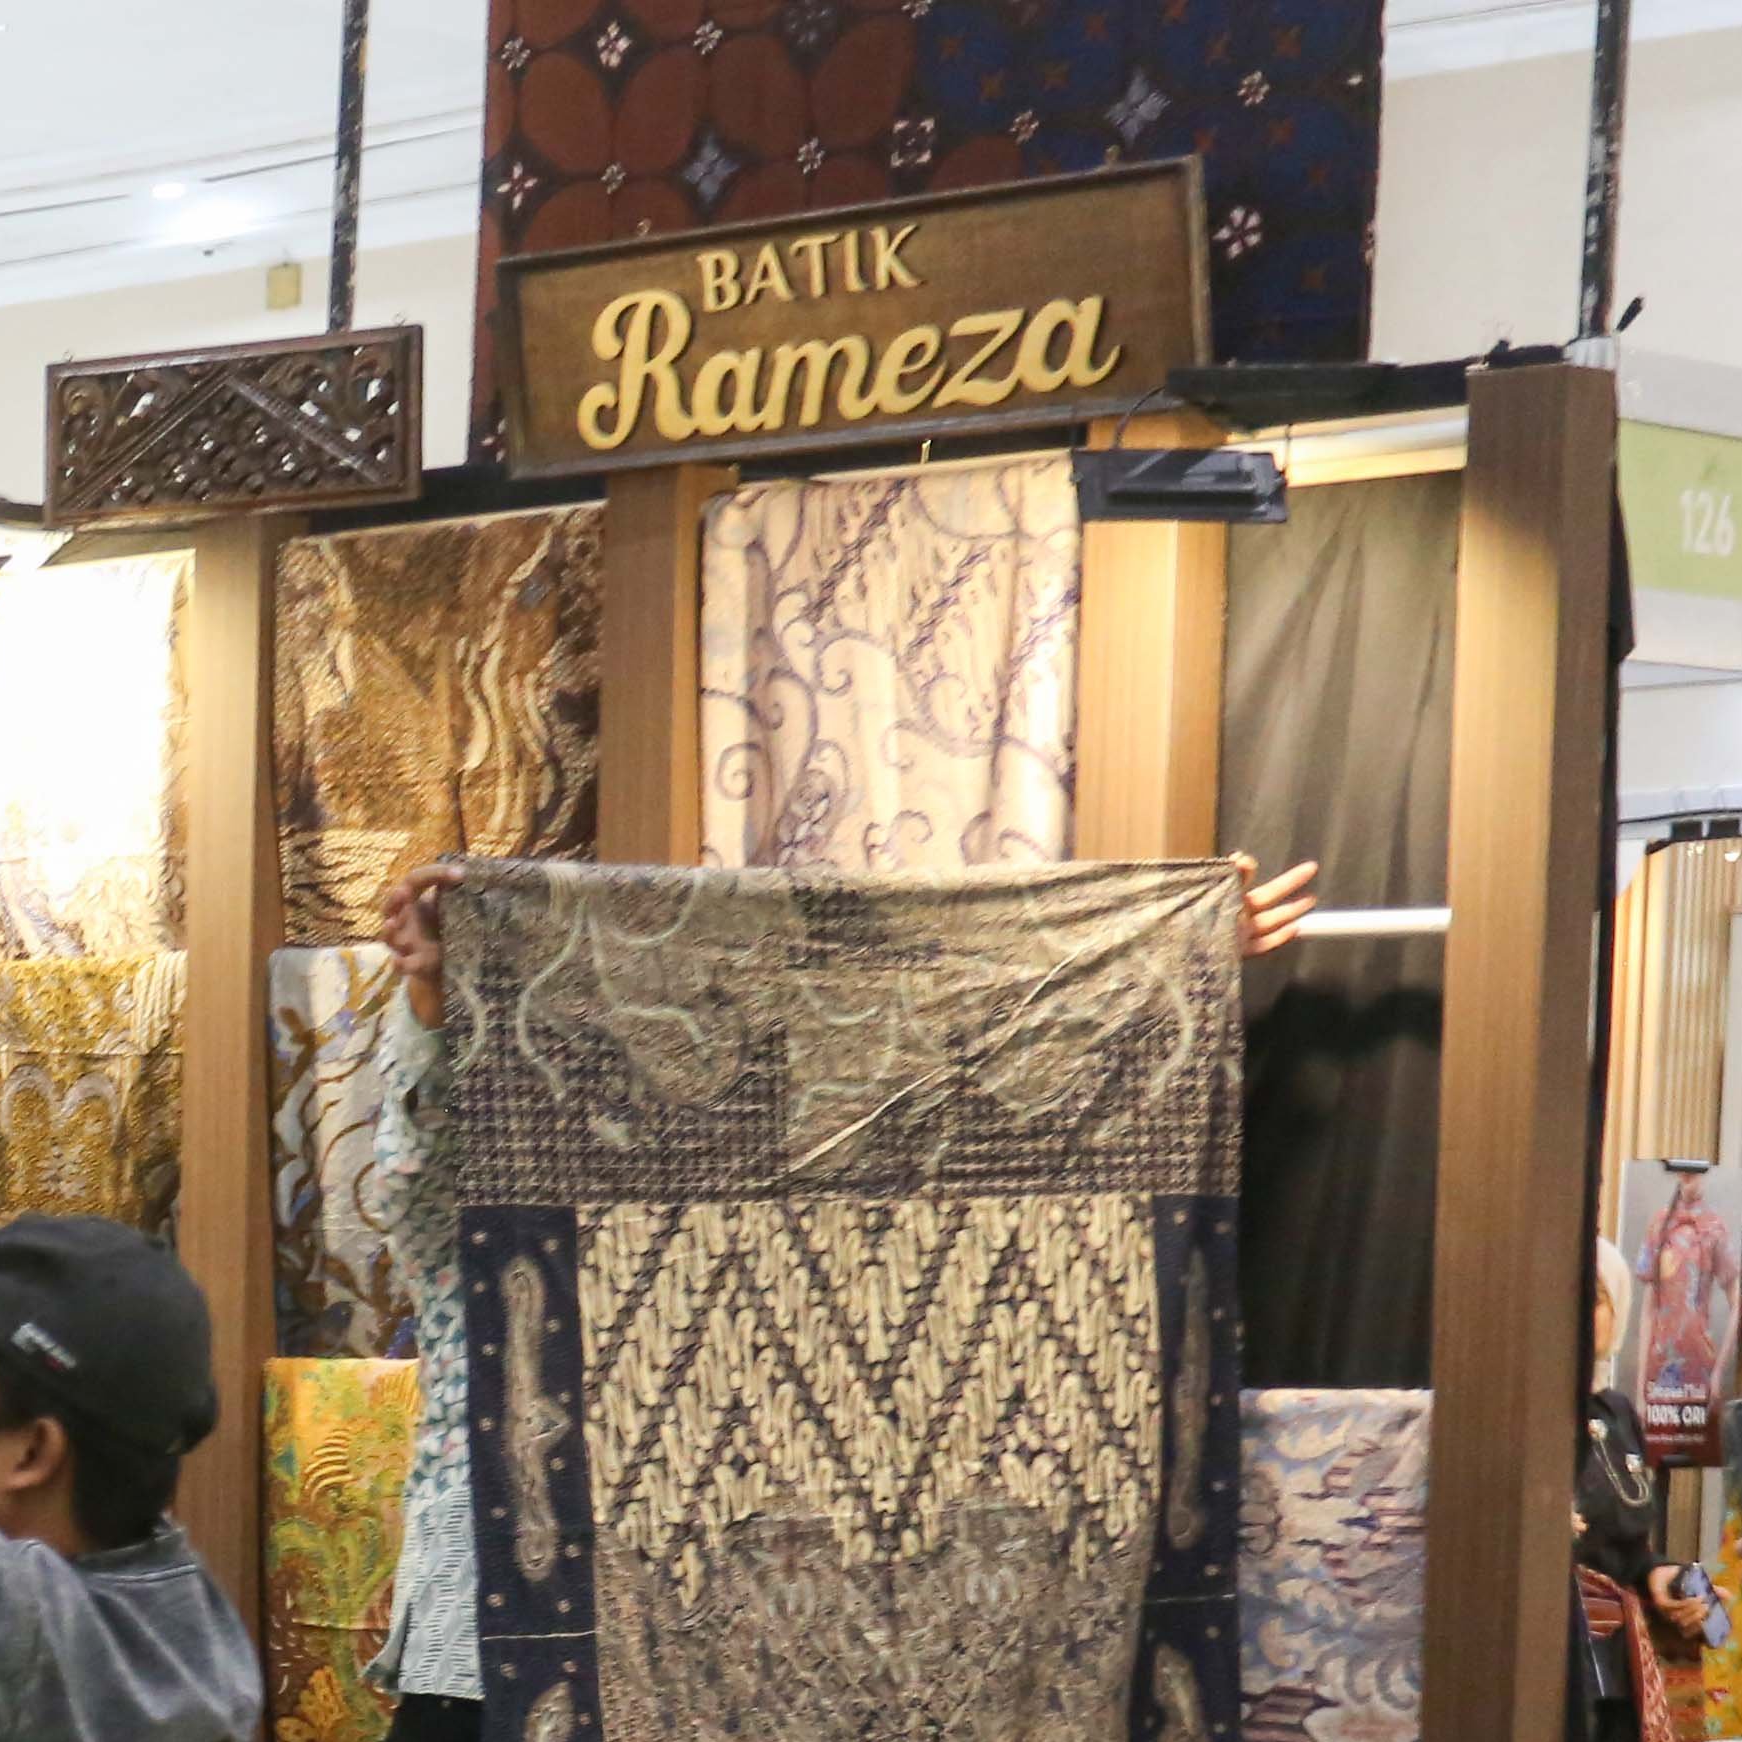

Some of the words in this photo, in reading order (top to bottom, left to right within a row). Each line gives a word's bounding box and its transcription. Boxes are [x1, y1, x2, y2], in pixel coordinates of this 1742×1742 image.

[696, 223, 921, 313] BATIK
[577, 294, 1121, 450] Rameza
[1679, 489, 1735, 557] 126
